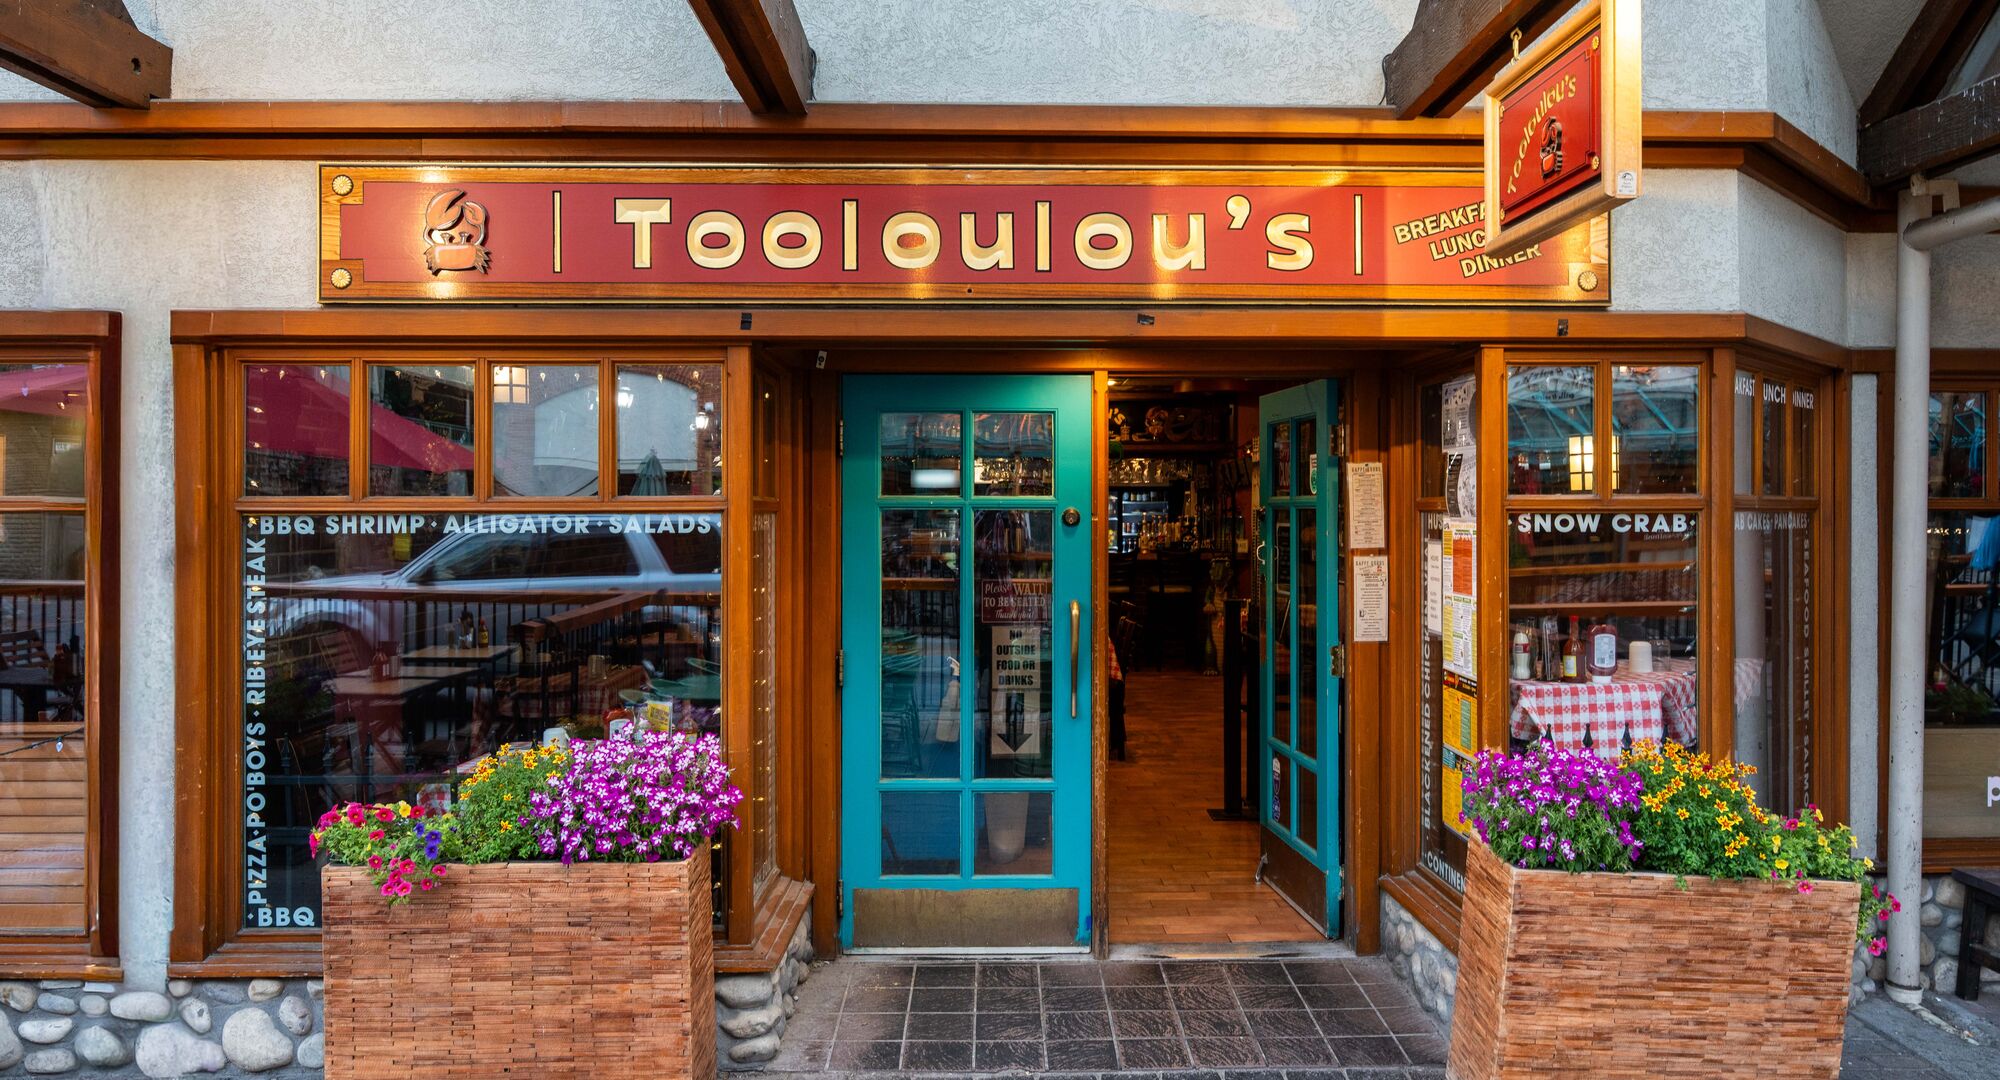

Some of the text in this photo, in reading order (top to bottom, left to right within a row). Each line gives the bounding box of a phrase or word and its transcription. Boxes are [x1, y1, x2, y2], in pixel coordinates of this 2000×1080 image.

[1507, 74, 1577, 194] Tooloulou's
[613, 194, 1316, 273] Tooloulou's
[1393, 201, 1485, 244] BREAKF
[1429, 230, 1487, 261] LUNC
[1734, 376, 1814, 409] AKFAST UNCH INNER
[260, 513, 711, 535] BBQ SHRIMP ALLIGATOR SALADS
[1428, 512, 1444, 531] HUS
[1517, 513, 1688, 533] SNOW CRAB
[1734, 512, 1808, 530] AB CAKES PANCAKES
[247, 538, 266, 614] STEAK
[985, 582, 1044, 596] Please WAIT
[984, 597, 1045, 607] TO BE SEATED
[1009, 630, 1022, 640] NO
[996, 645, 1035, 655] OUTSIDE
[996, 660, 1035, 670] FOOD OR
[998, 676, 1033, 686] DRINKS
[246, 722, 266, 828] PO'BOYS
[1987, 775, 2000, 807] p
[248, 835, 267, 905] PIZZA
[1426, 850, 1466, 893] CONTINEN
[258, 906, 315, 927] BBQ
